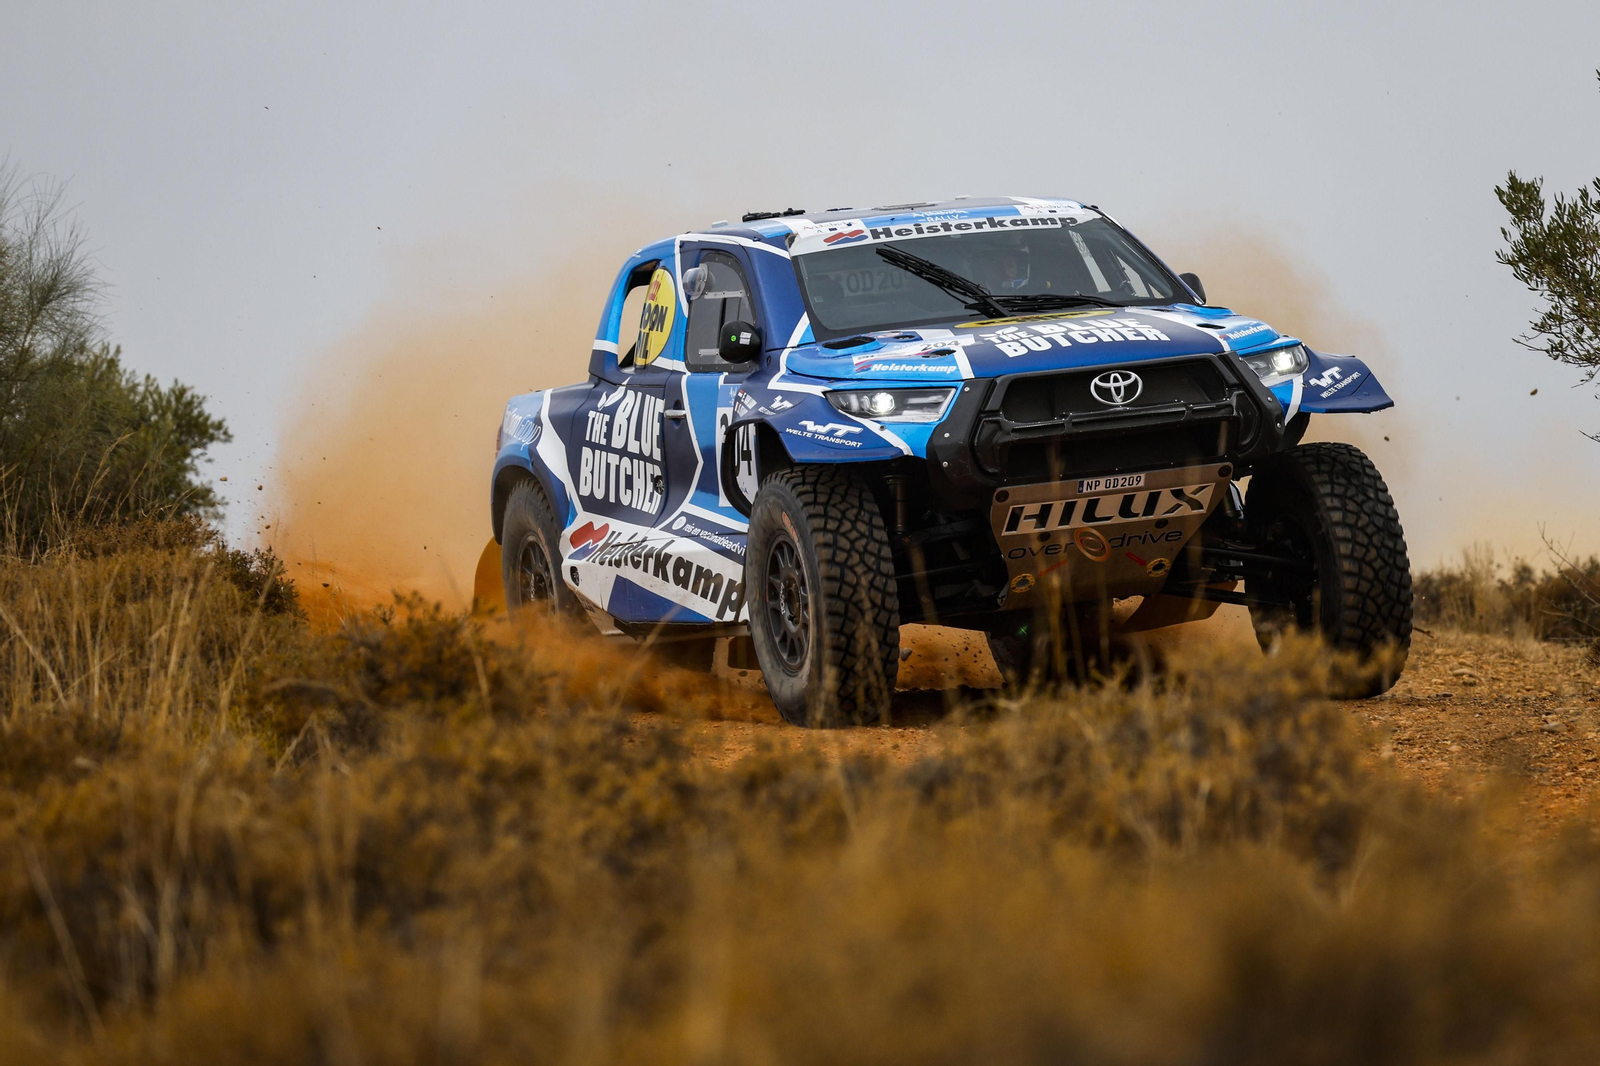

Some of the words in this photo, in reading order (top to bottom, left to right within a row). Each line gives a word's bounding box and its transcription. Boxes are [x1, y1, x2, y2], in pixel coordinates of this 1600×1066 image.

[869, 216, 1078, 240] Heisterkamp
[984, 330, 1034, 344] THE
[1026, 318, 1152, 335] BLUE
[995, 327, 1171, 358] BUTCHER
[920, 340, 961, 351] 204
[871, 363, 957, 374] Heisterkamp
[1309, 366, 1343, 388] WT
[1320, 385, 1338, 399] WELTE
[1336, 371, 1361, 389] TRANSPORT
[585, 410, 611, 445] THE
[611, 389, 665, 462] BLUE
[785, 427, 813, 438] WELTE
[814, 433, 863, 448] TRANSPORT
[799, 420, 864, 437] WT
[1086, 480, 1101, 492] NP
[1003, 484, 1213, 534] HILUX
[1008, 540, 1075, 560] over
[1108, 529, 1184, 549] drive
[586, 530, 743, 621] Heisterkamp
